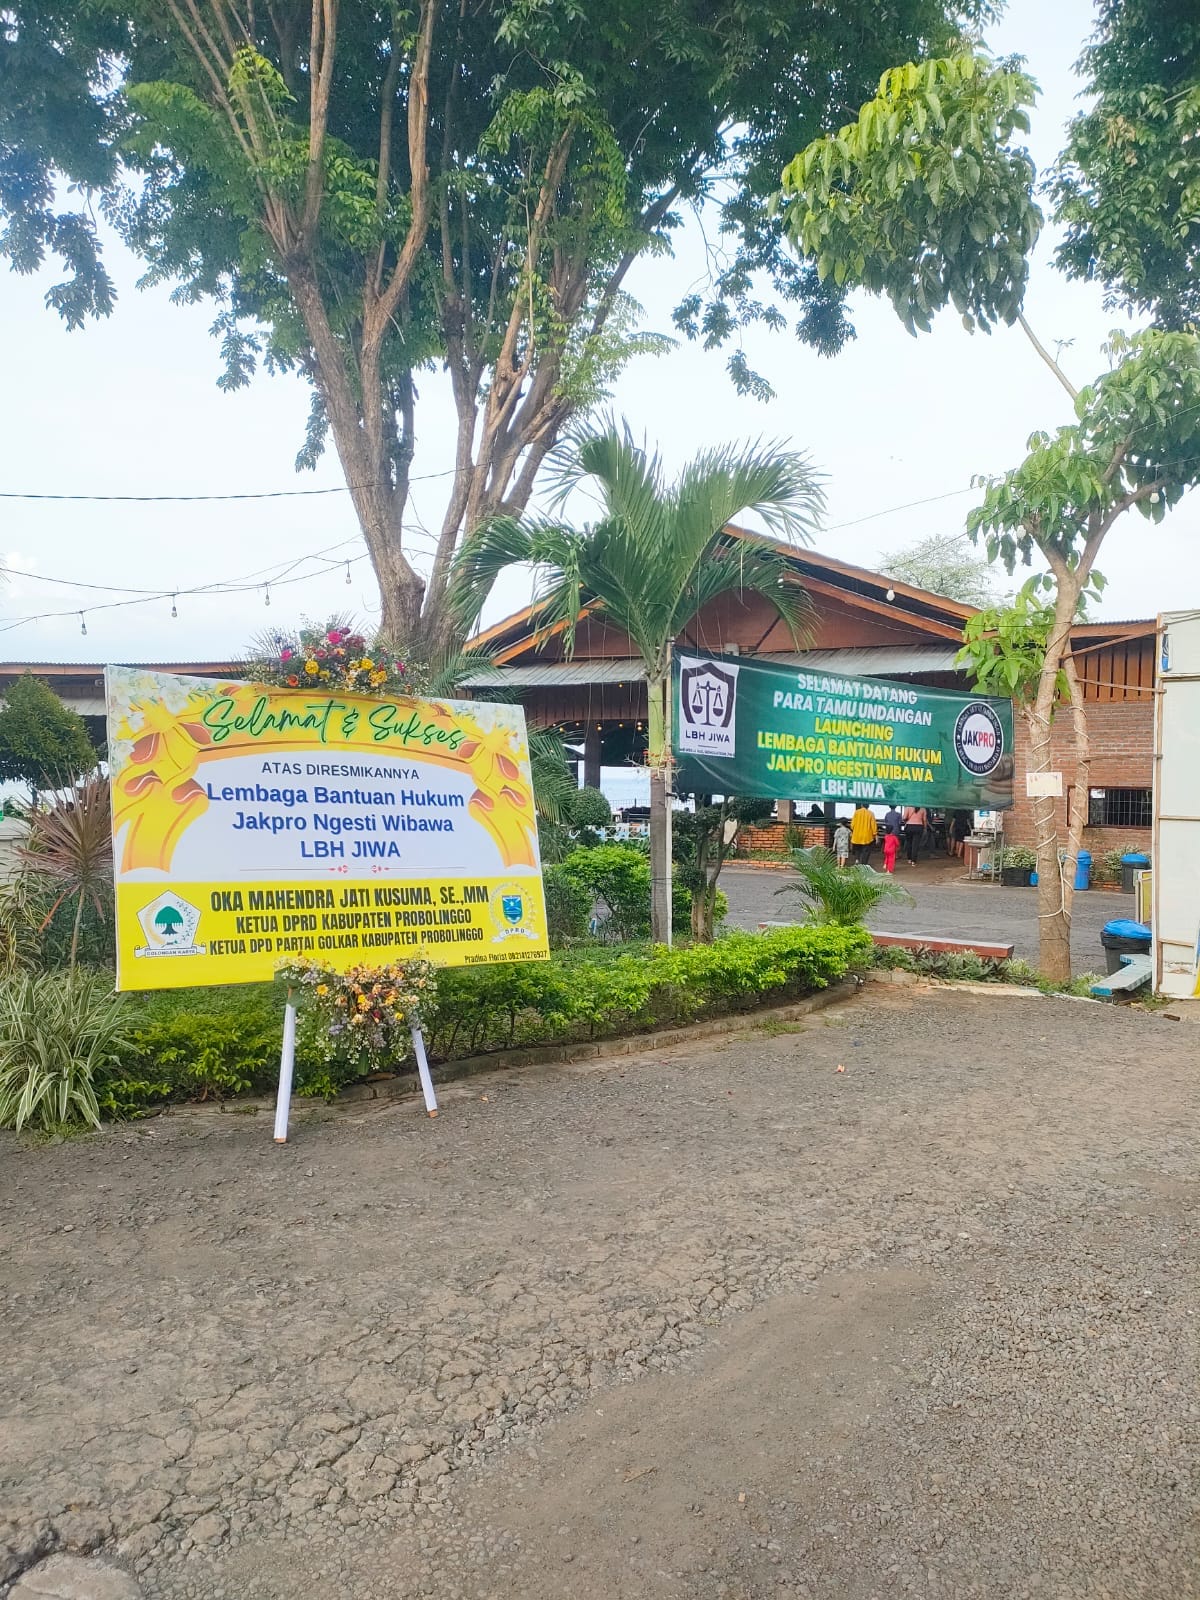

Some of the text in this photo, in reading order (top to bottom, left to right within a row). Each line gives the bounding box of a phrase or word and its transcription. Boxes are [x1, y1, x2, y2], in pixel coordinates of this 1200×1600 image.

[798, 673, 918, 704] SELAMAT DATANG
[773, 691, 813, 713] PARA
[815, 696, 857, 718] TAMU
[858, 702, 932, 726] UNDANGAN
[203, 697, 466, 751] Selamat & Sukses
[685, 729, 730, 743] LBH JIWA
[815, 717, 894, 741] LAUNCHING
[757, 731, 826, 754] LEMBAGA
[828, 738, 893, 761] BANTUAN
[895, 746, 942, 765] HUKUM
[962, 729, 995, 748] JAKPRO
[261, 762, 420, 780] ATAS DIRESMIKANNYA
[766, 754, 934, 783] JAKPRO NGESTI WIBAWA
[207, 783, 465, 807] Lembaga Bantuan Hukum
[821, 779, 886, 798] LBH JIWA
[232, 812, 455, 835] Jakpro Ngesti Wibawa
[300, 840, 401, 858] LBH JIWA
[210, 885, 490, 912] OKA MAHENDRA JATI KUSUMA, SE.,MM
[236, 908, 472, 934] KETUA DPRD KABUPATEN PROBOLINGGO
[210, 927, 484, 955] KETUA DPD PARTAI GOLKAR KABUPATEN PROBOLINGGO
